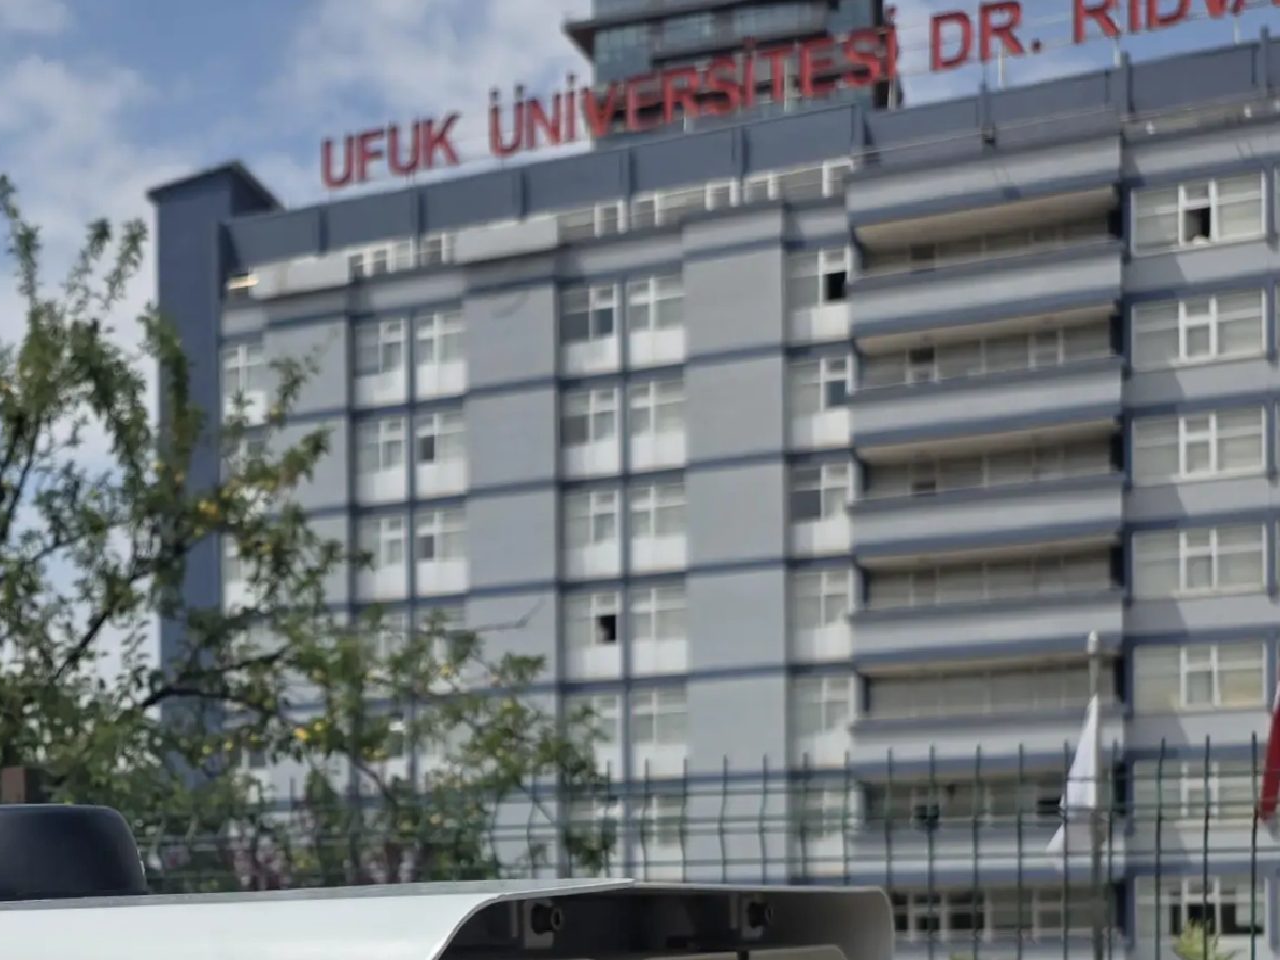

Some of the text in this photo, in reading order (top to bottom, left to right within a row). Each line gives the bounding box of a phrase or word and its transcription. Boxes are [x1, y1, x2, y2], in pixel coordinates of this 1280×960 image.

[321, 111, 461, 188] UFUK
[487, 5, 898, 156] ÜNİVERSİTESİ
[930, 2, 1041, 71] DR.
